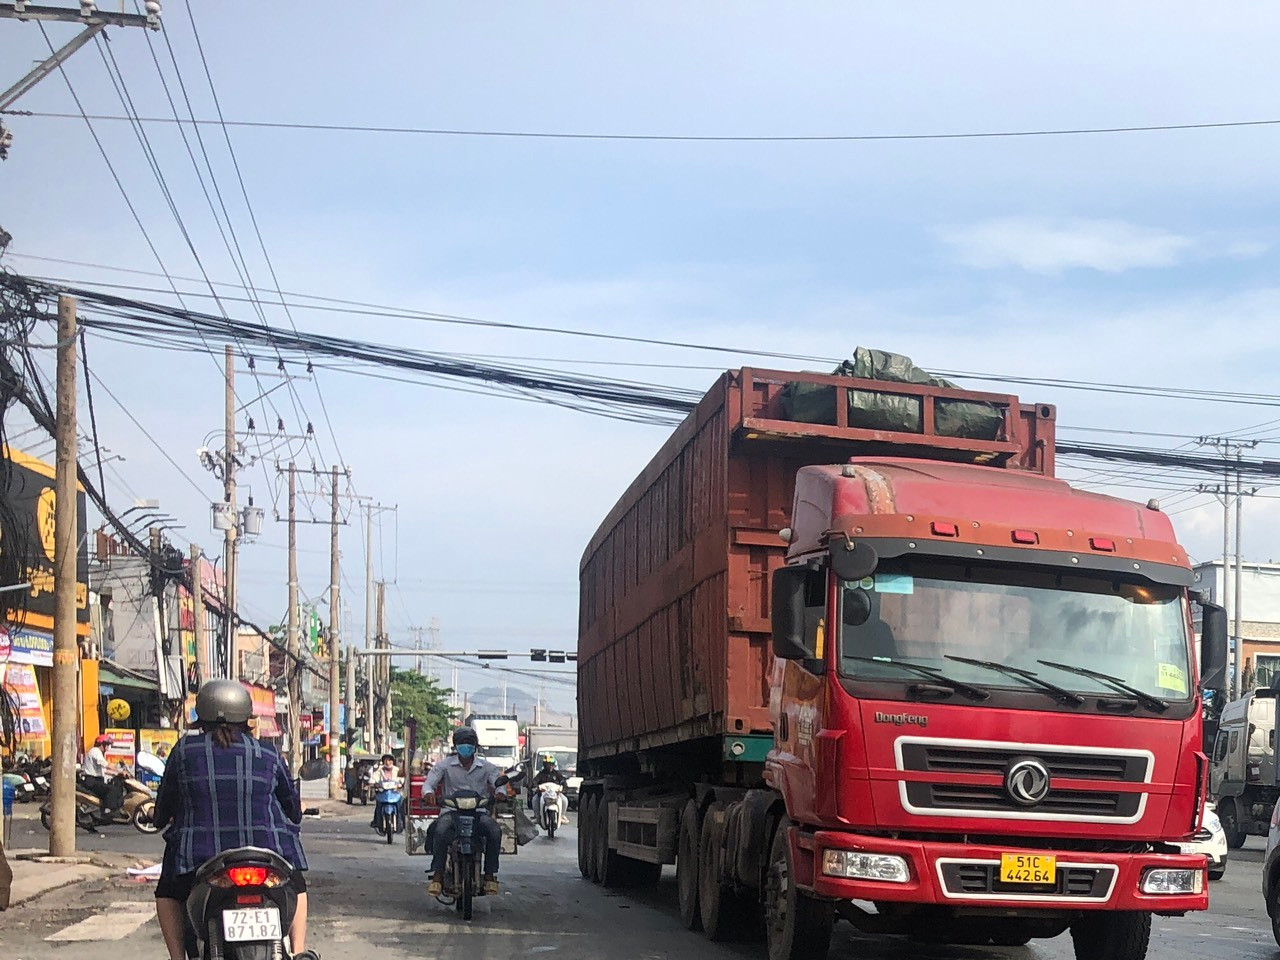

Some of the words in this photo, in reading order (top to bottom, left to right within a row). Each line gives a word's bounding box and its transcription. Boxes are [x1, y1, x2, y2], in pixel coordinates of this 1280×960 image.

[874, 711, 928, 727] DongFeng
[1016, 856, 1040, 869] 51C
[1006, 870, 1050, 882] 442.64
[232, 911, 270, 925] 72-E1
[228, 925, 278, 938] 871.82
